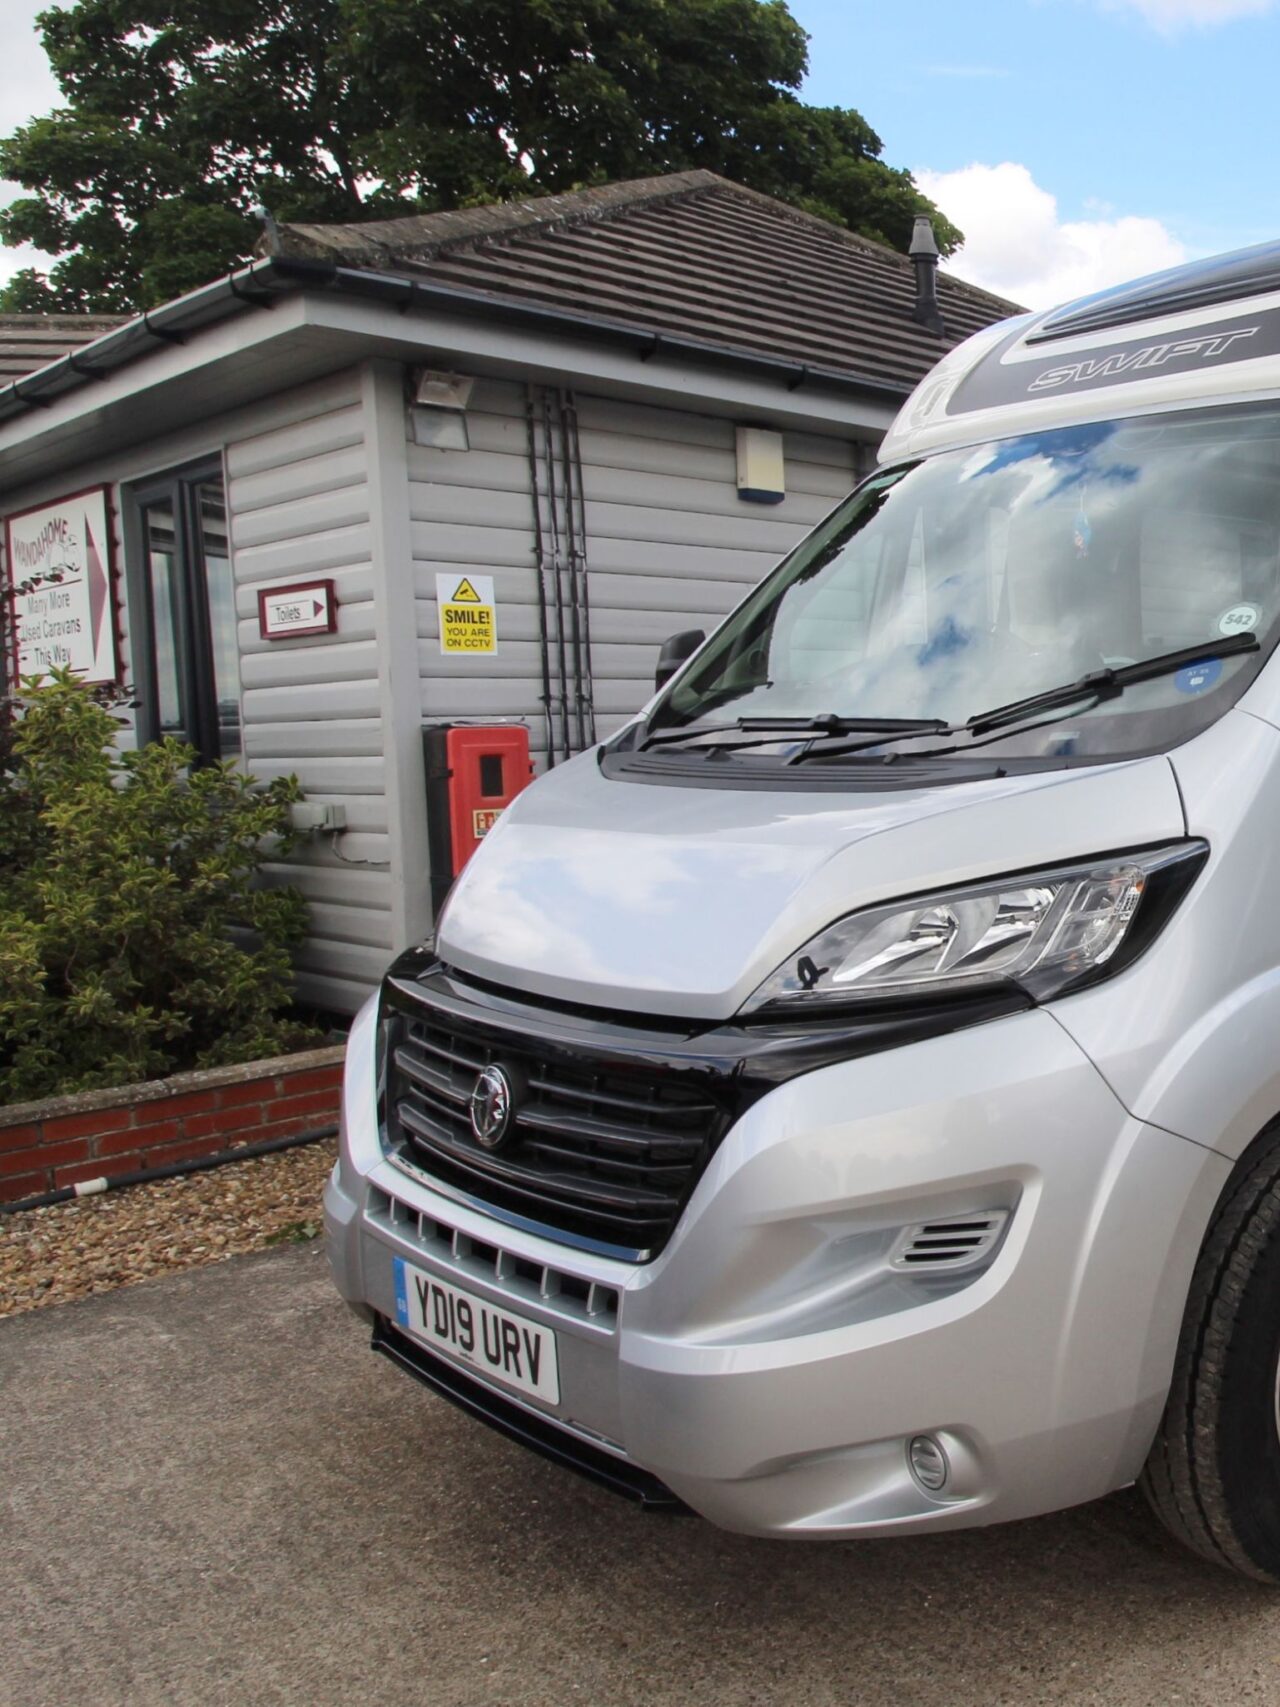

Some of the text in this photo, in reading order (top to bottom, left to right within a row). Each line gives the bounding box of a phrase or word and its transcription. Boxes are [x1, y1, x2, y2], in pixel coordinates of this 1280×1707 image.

[1028, 326, 1260, 392] SWIFT
[14, 517, 68, 567] WANDAHOME
[28, 591, 70, 616] Many More
[275, 605, 301, 621] Toilets
[445, 609, 490, 625] SMILE!
[1225, 613, 1252, 625] 542
[21, 618, 81, 642] Used Caravans
[447, 627, 490, 638] YOU ARE
[446, 638, 490, 648] ON CCTV
[34, 644, 71, 667] This Way
[415, 1275, 542, 1386] YD19 URV
